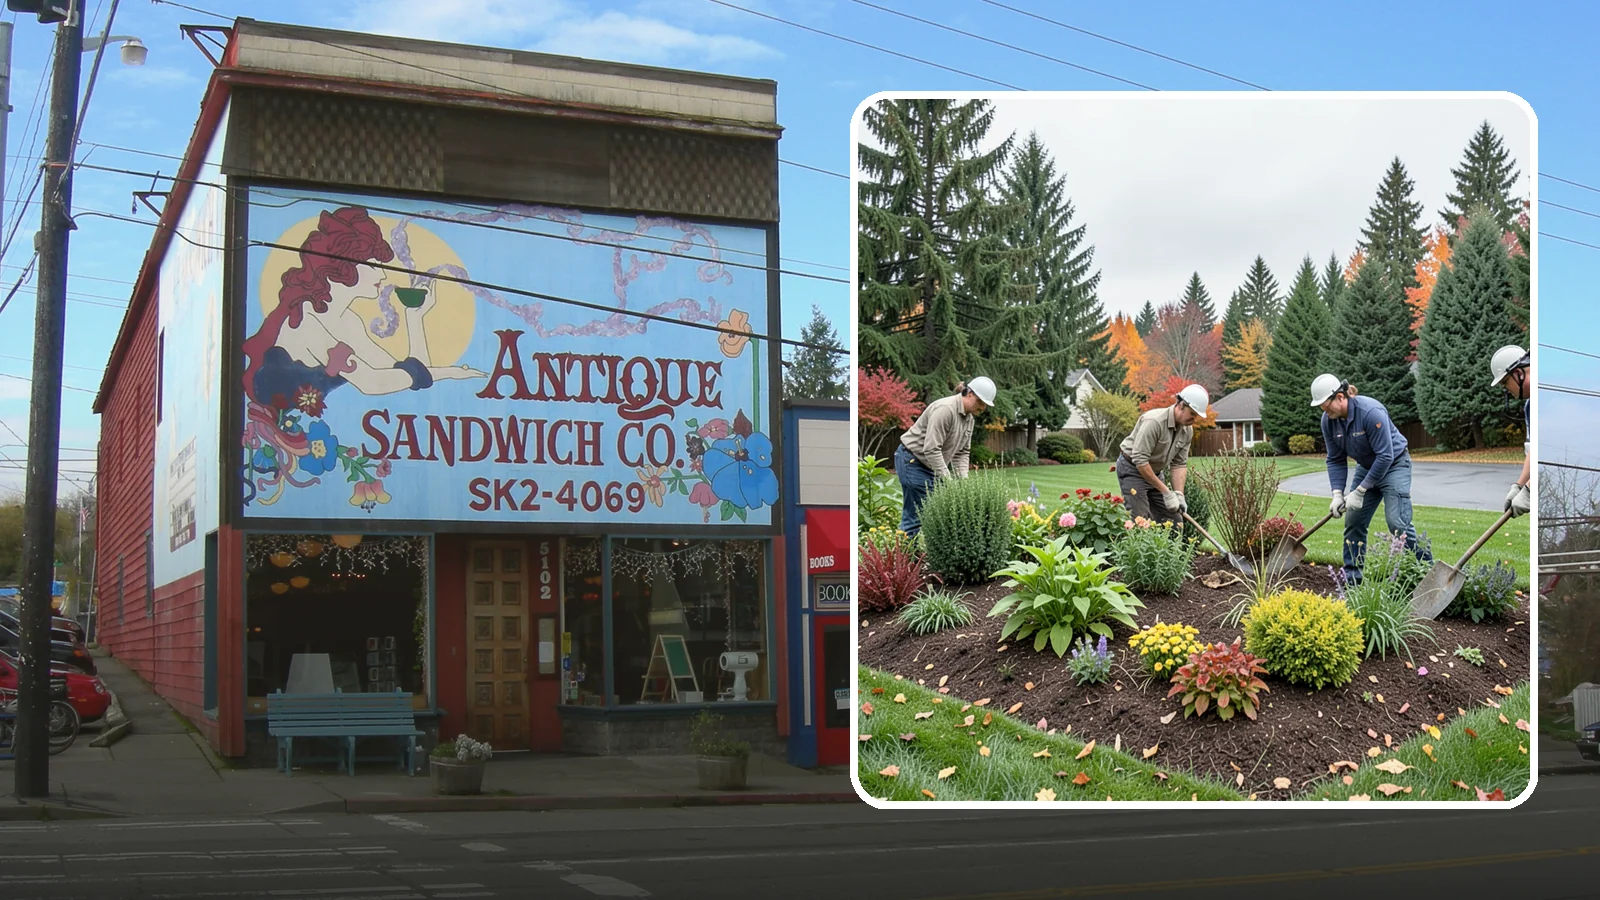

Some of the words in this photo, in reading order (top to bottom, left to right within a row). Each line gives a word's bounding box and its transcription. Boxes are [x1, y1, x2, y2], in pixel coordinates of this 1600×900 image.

[476, 330, 723, 420] ANTIQUE
[362, 408, 604, 467] SANDWICH
[616, 422, 685, 468] CO.
[469, 478, 646, 513] SK2-4069
[540, 541, 551, 599] 5102
[809, 555, 835, 569] BOOKS
